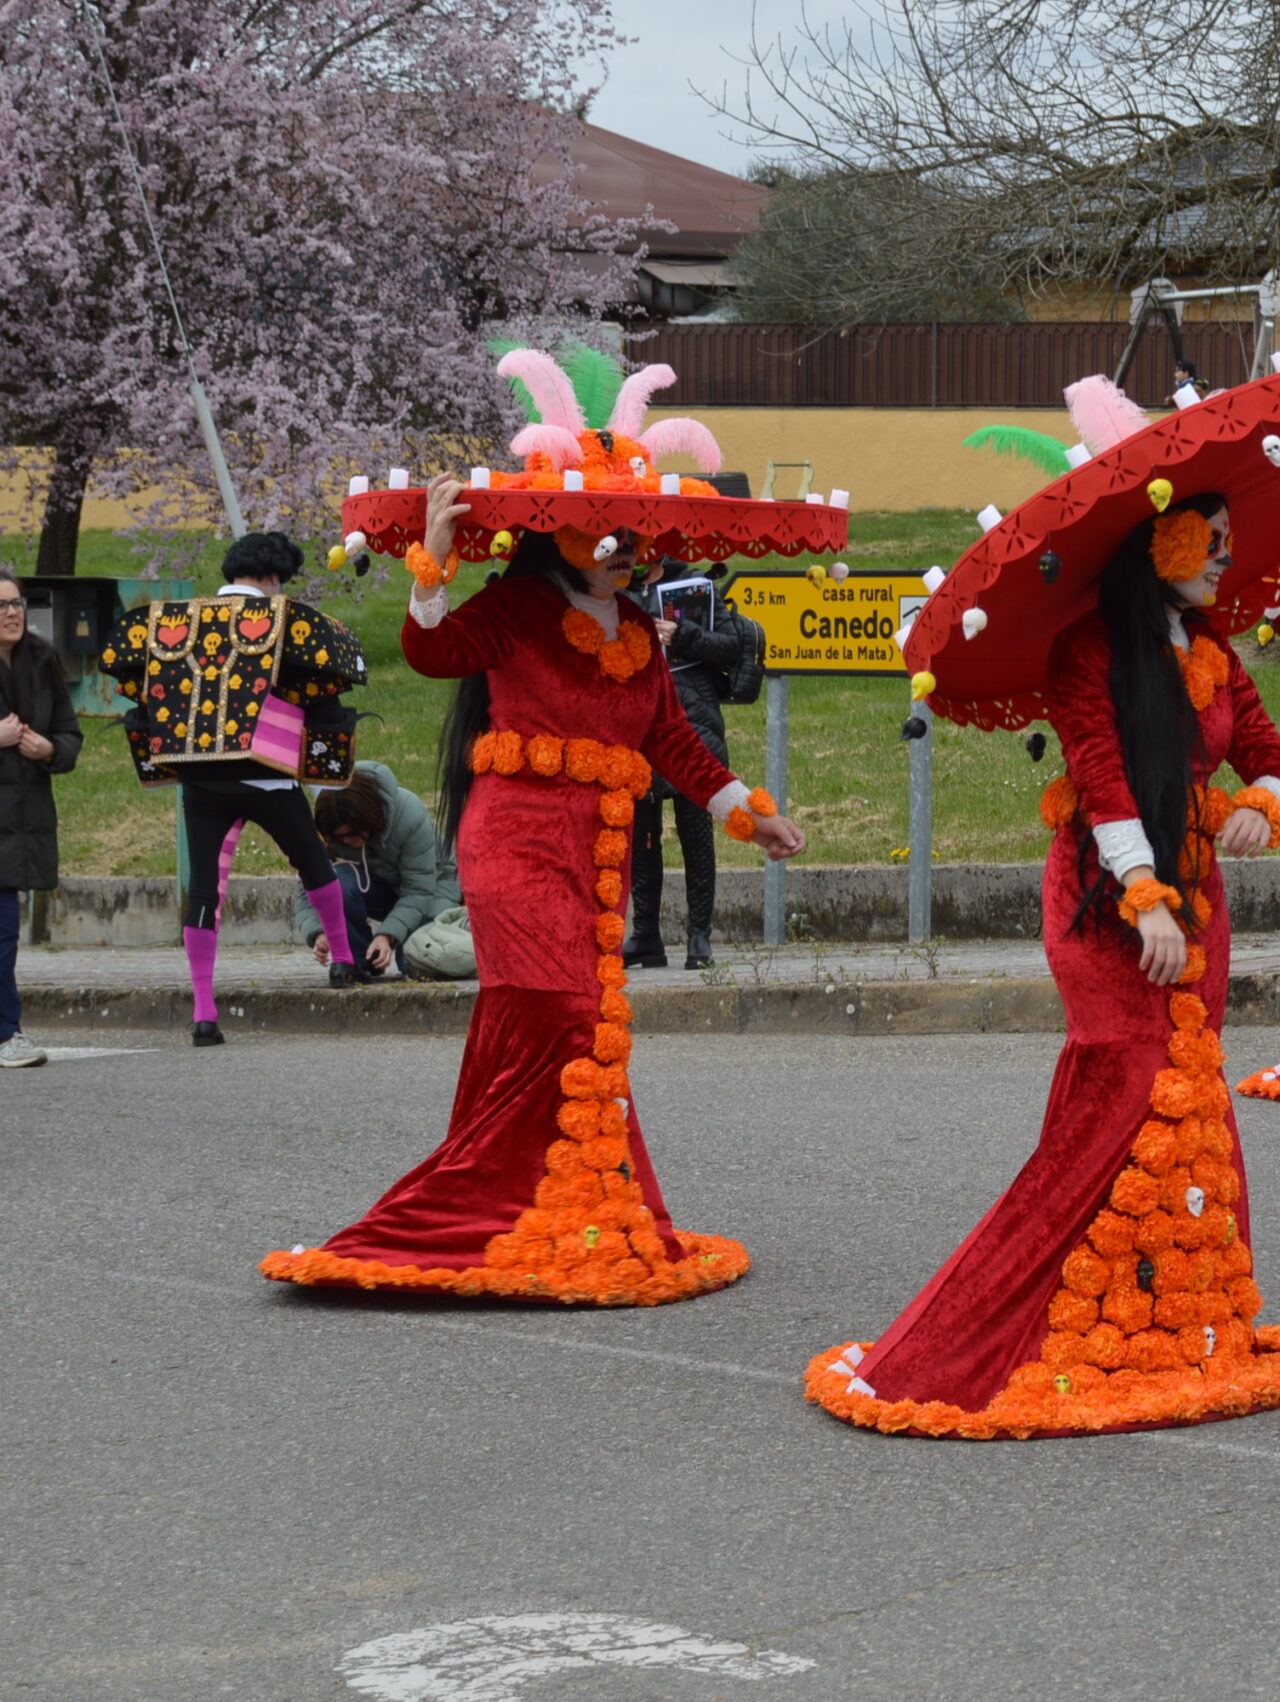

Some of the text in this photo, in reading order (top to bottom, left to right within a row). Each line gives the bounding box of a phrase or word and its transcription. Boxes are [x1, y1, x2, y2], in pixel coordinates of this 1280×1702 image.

[744, 587, 785, 606] 3,5 km
[823, 585, 894, 602] casa rural
[800, 609, 894, 639] Canedo
[765, 646, 894, 662] San Juan de la Mata)
